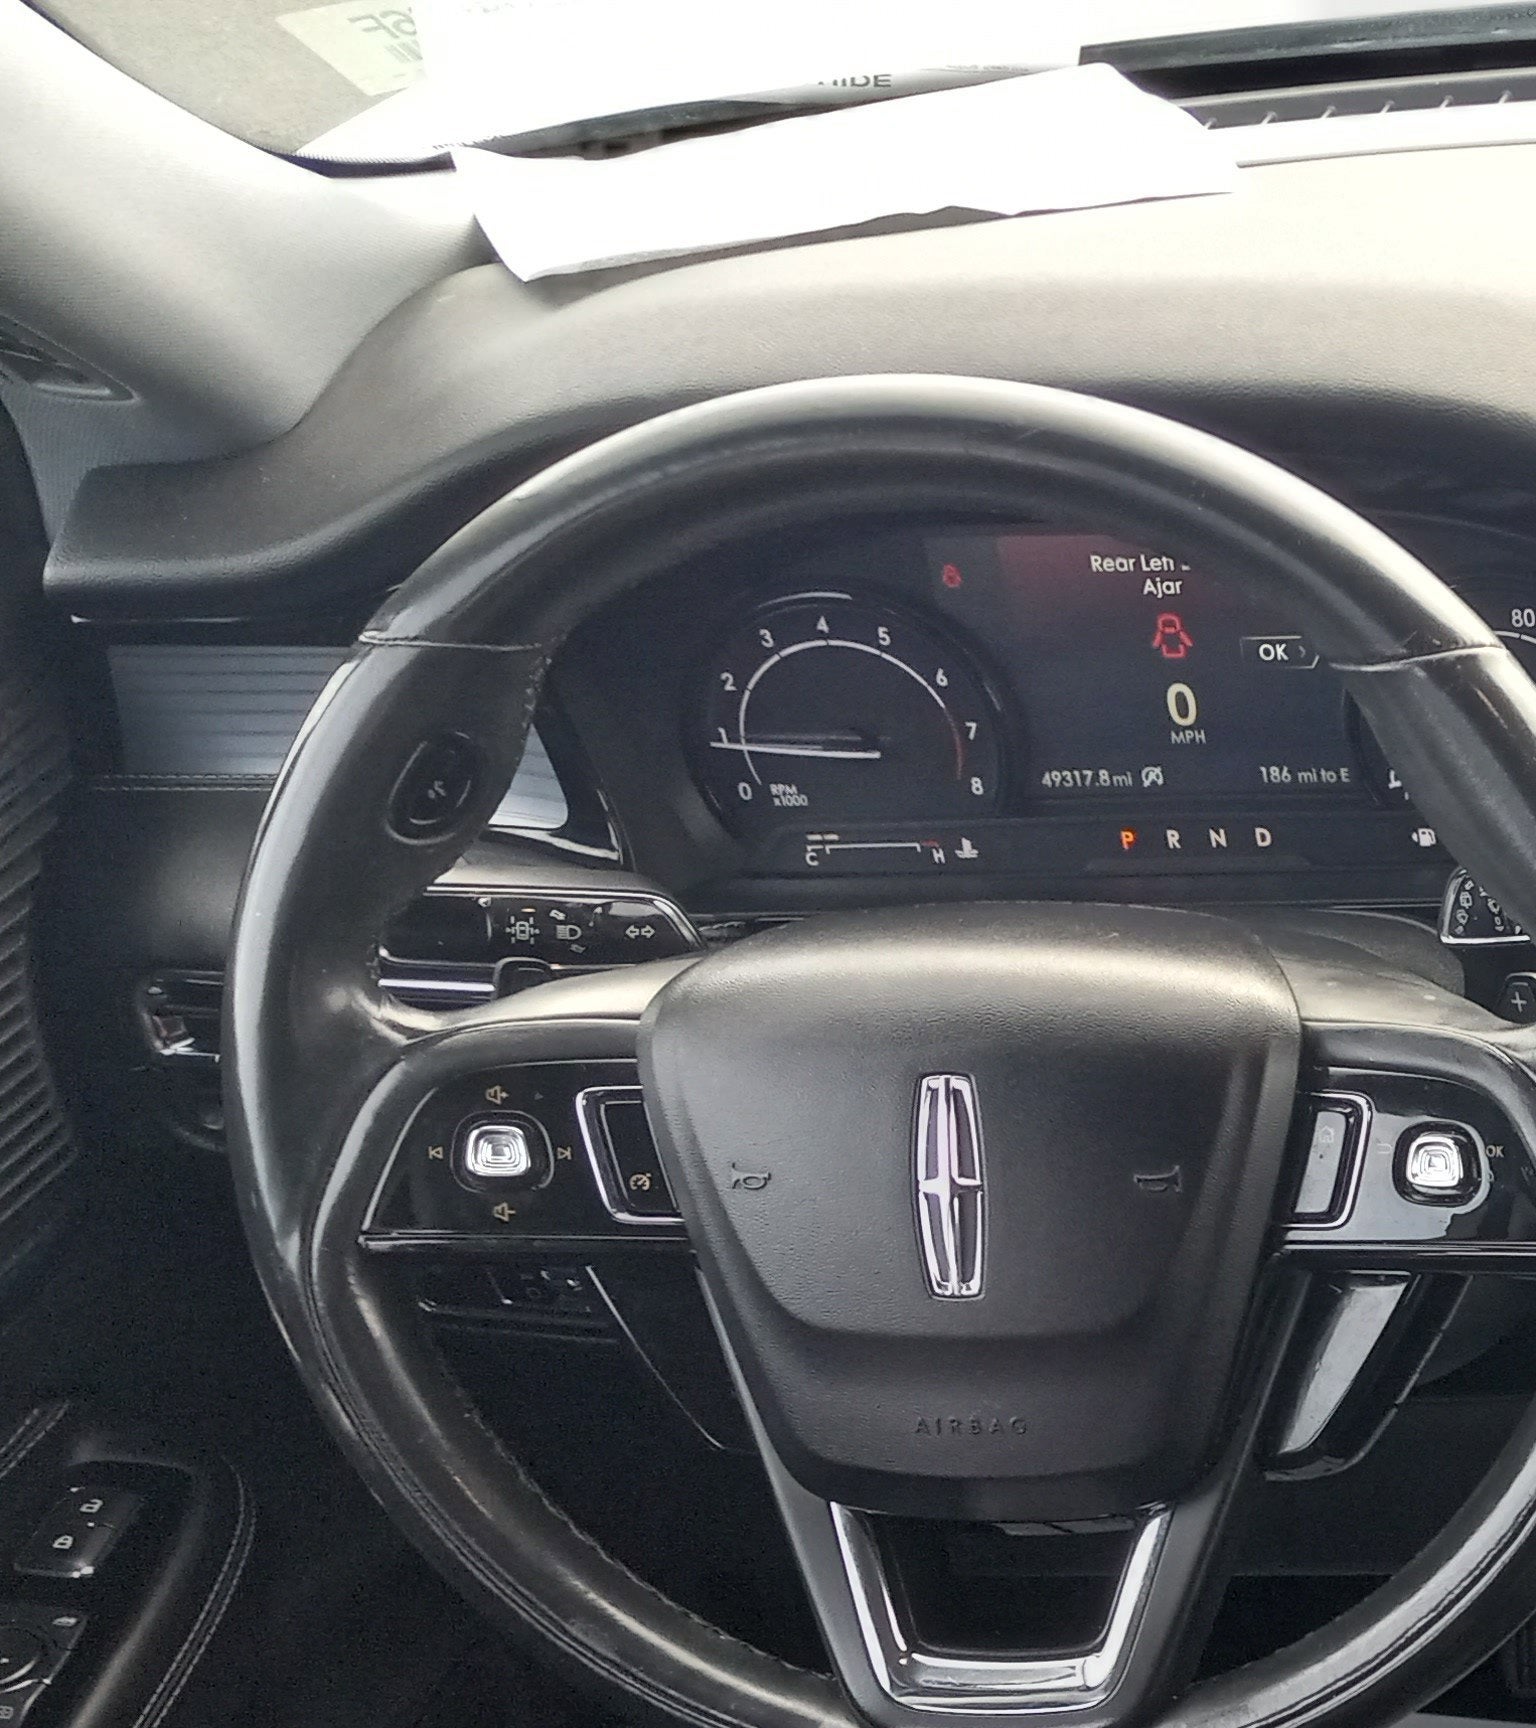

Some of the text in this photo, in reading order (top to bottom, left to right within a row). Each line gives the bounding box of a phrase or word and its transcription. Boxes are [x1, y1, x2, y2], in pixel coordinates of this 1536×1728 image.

[1089, 554, 1136, 572] Rear
[1143, 577, 1182, 599] Ajar
[816, 616, 829, 634] 4
[1511, 609, 1536, 628] 80
[760, 629, 773, 648] 3
[878, 627, 891, 646] 5
[1258, 644, 1289, 661] OK
[723, 673, 737, 691] 2
[935, 668, 948, 687] 6
[1166, 683, 1198, 727] 0
[965, 722, 978, 740] 7
[1171, 730, 1206, 744] MPH
[1259, 766, 1350, 783] 186 mi to E
[738, 782, 752, 800] 0
[769, 783, 798, 795] RPM
[971, 777, 984, 796] 8
[1120, 828, 1272, 849] P R N D
[805, 851, 819, 866] C
[933, 848, 945, 864] H
[1485, 1146, 1505, 1158] OK
[915, 1416, 1028, 1436] AIRBAG
